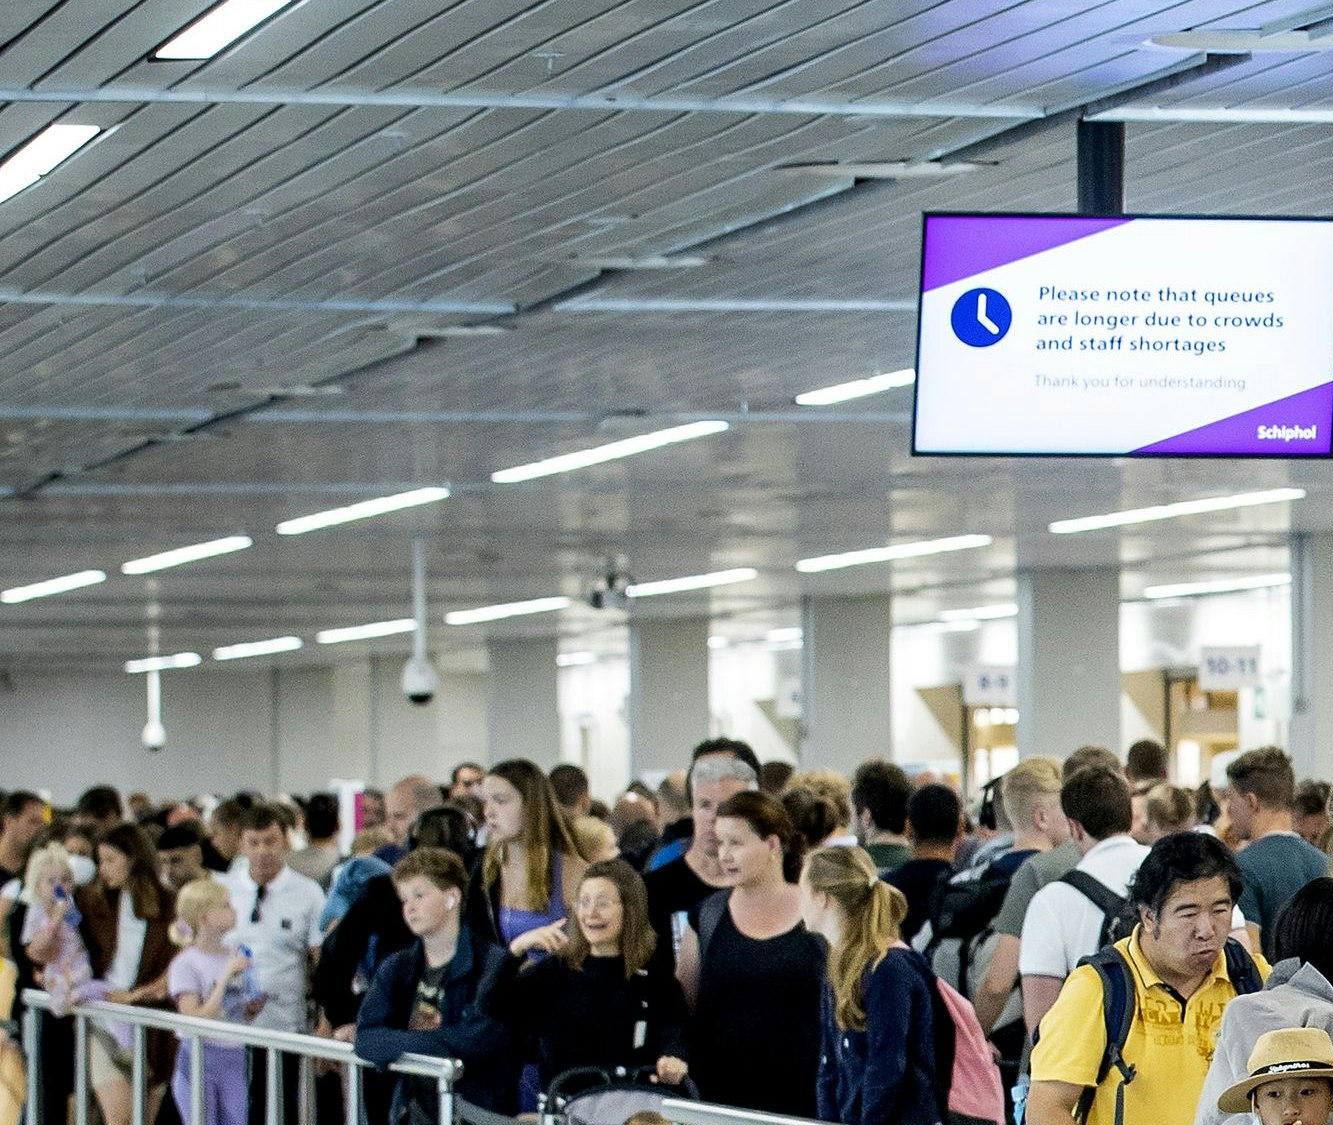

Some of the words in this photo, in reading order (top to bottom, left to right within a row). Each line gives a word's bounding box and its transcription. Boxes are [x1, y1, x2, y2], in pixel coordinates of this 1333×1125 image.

[1039, 286, 1100, 302] Please
[1106, 288, 1151, 303] note
[1159, 287, 1197, 303] that
[1204, 289, 1275, 306] queues
[1037, 314, 1068, 327] are
[1075, 311, 1139, 330] longer
[1145, 312, 1181, 327] due
[1188, 314, 1207, 328] to
[1214, 313, 1284, 329] crowds
[1036, 336, 1073, 351] and
[1079, 336, 1124, 351] staff
[1130, 336, 1226, 356] shortages
[1035, 373, 1078, 388] Thank
[1083, 377, 1110, 391] you
[1114, 375, 1134, 388] for
[1138, 376, 1247, 393] understanding
[1257, 424, 1317, 443] Schiphol
